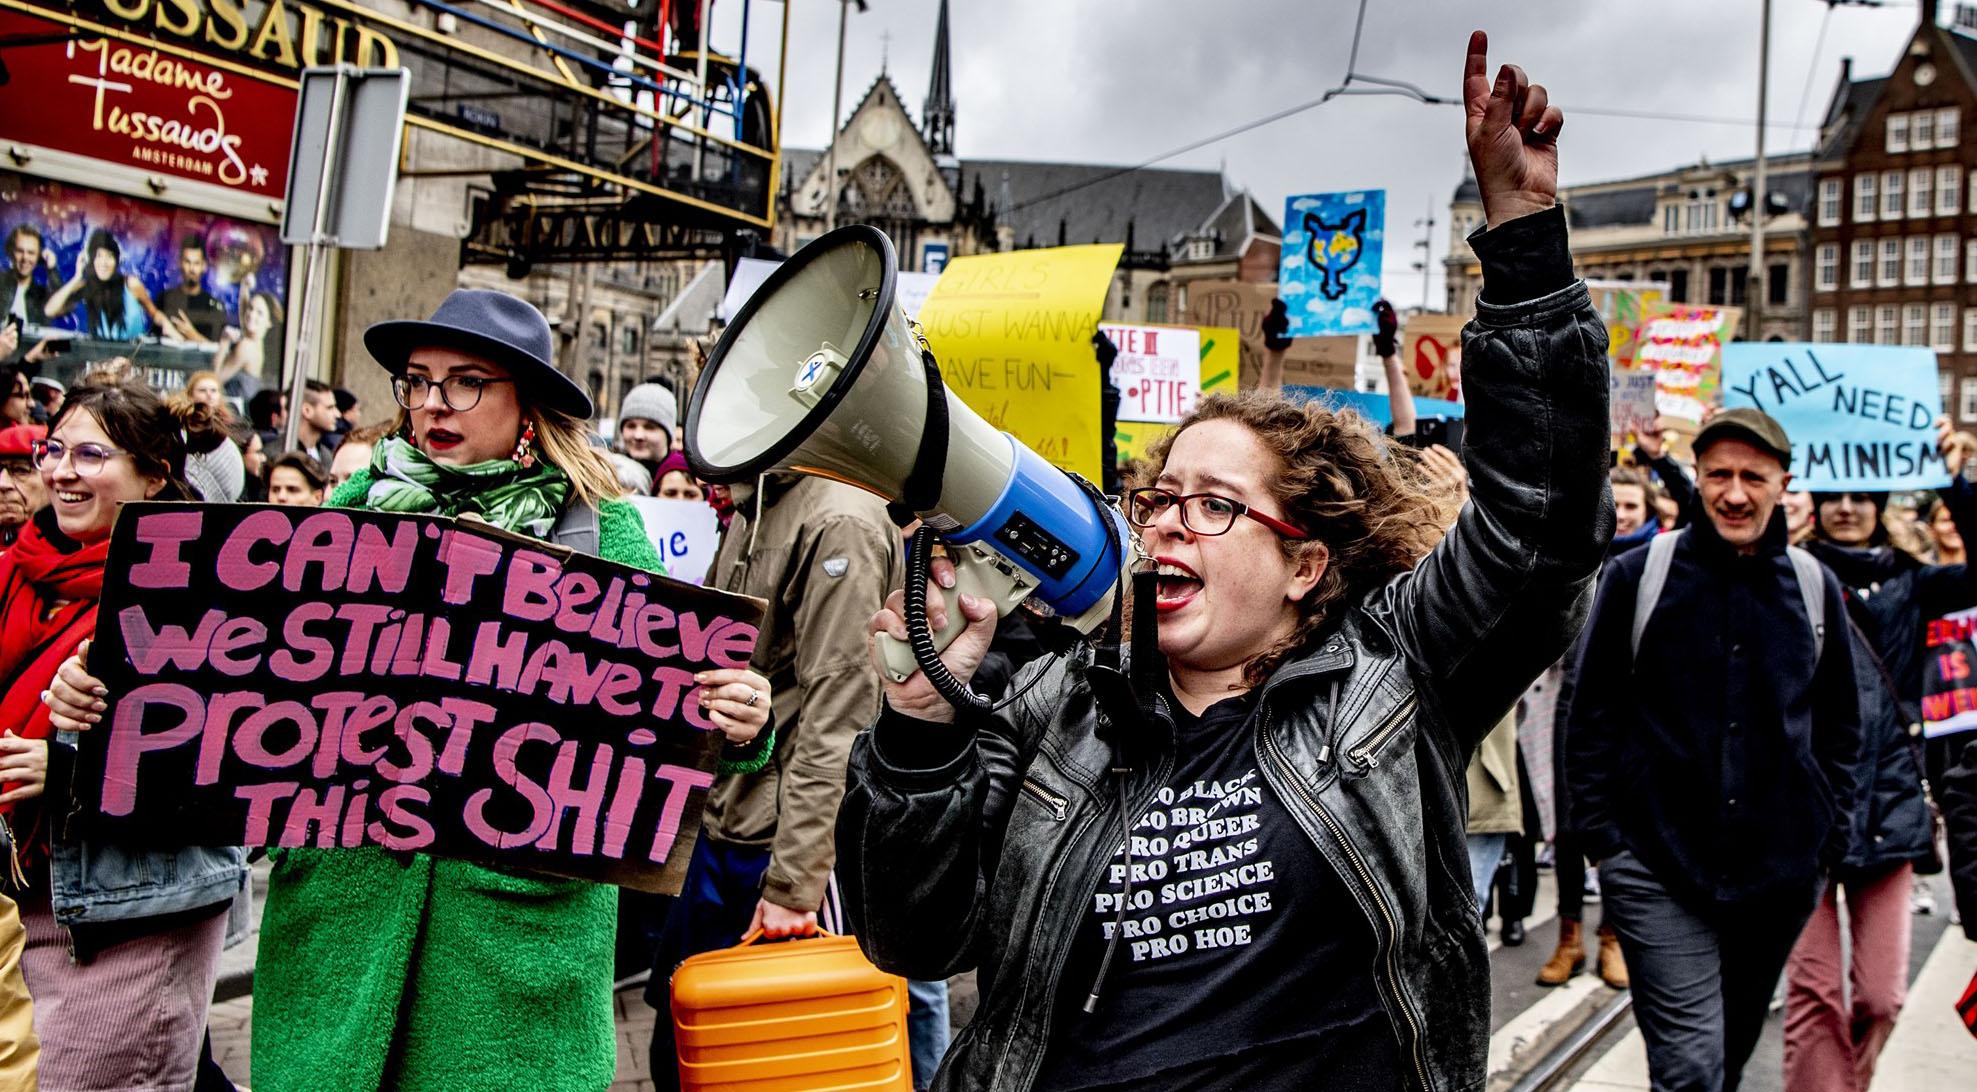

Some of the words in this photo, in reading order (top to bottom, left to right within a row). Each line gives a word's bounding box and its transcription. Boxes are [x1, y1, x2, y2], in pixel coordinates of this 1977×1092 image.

[67, 30, 233, 99] Madame
[68, 74, 248, 185] Tussauds
[132, 146, 213, 175] AMSTERDAM
[938, 262, 1050, 295] GIRLS
[927, 309, 993, 339] JUST
[1004, 310, 1096, 342] WANNA
[941, 357, 997, 391] AVE
[1731, 349, 1844, 413] Y'ALL
[1833, 384, 1932, 430] NEED
[129, 512, 203, 588] I
[216, 511, 502, 604] CAN'T
[1940, 651, 1970, 681] IS
[1171, 787, 1262, 827] BROWN
[1173, 814, 1260, 849] QUEER
[1109, 860, 1168, 884] PRO
[1174, 838, 1259, 873] TRANS
[1095, 889, 1154, 913] PRO
[1161, 861, 1274, 904] SCIENCE
[1102, 916, 1162, 940] PRO
[1168, 892, 1272, 928] CHOICE
[1131, 934, 1188, 962] PRO
[1194, 924, 1252, 949] HOE
